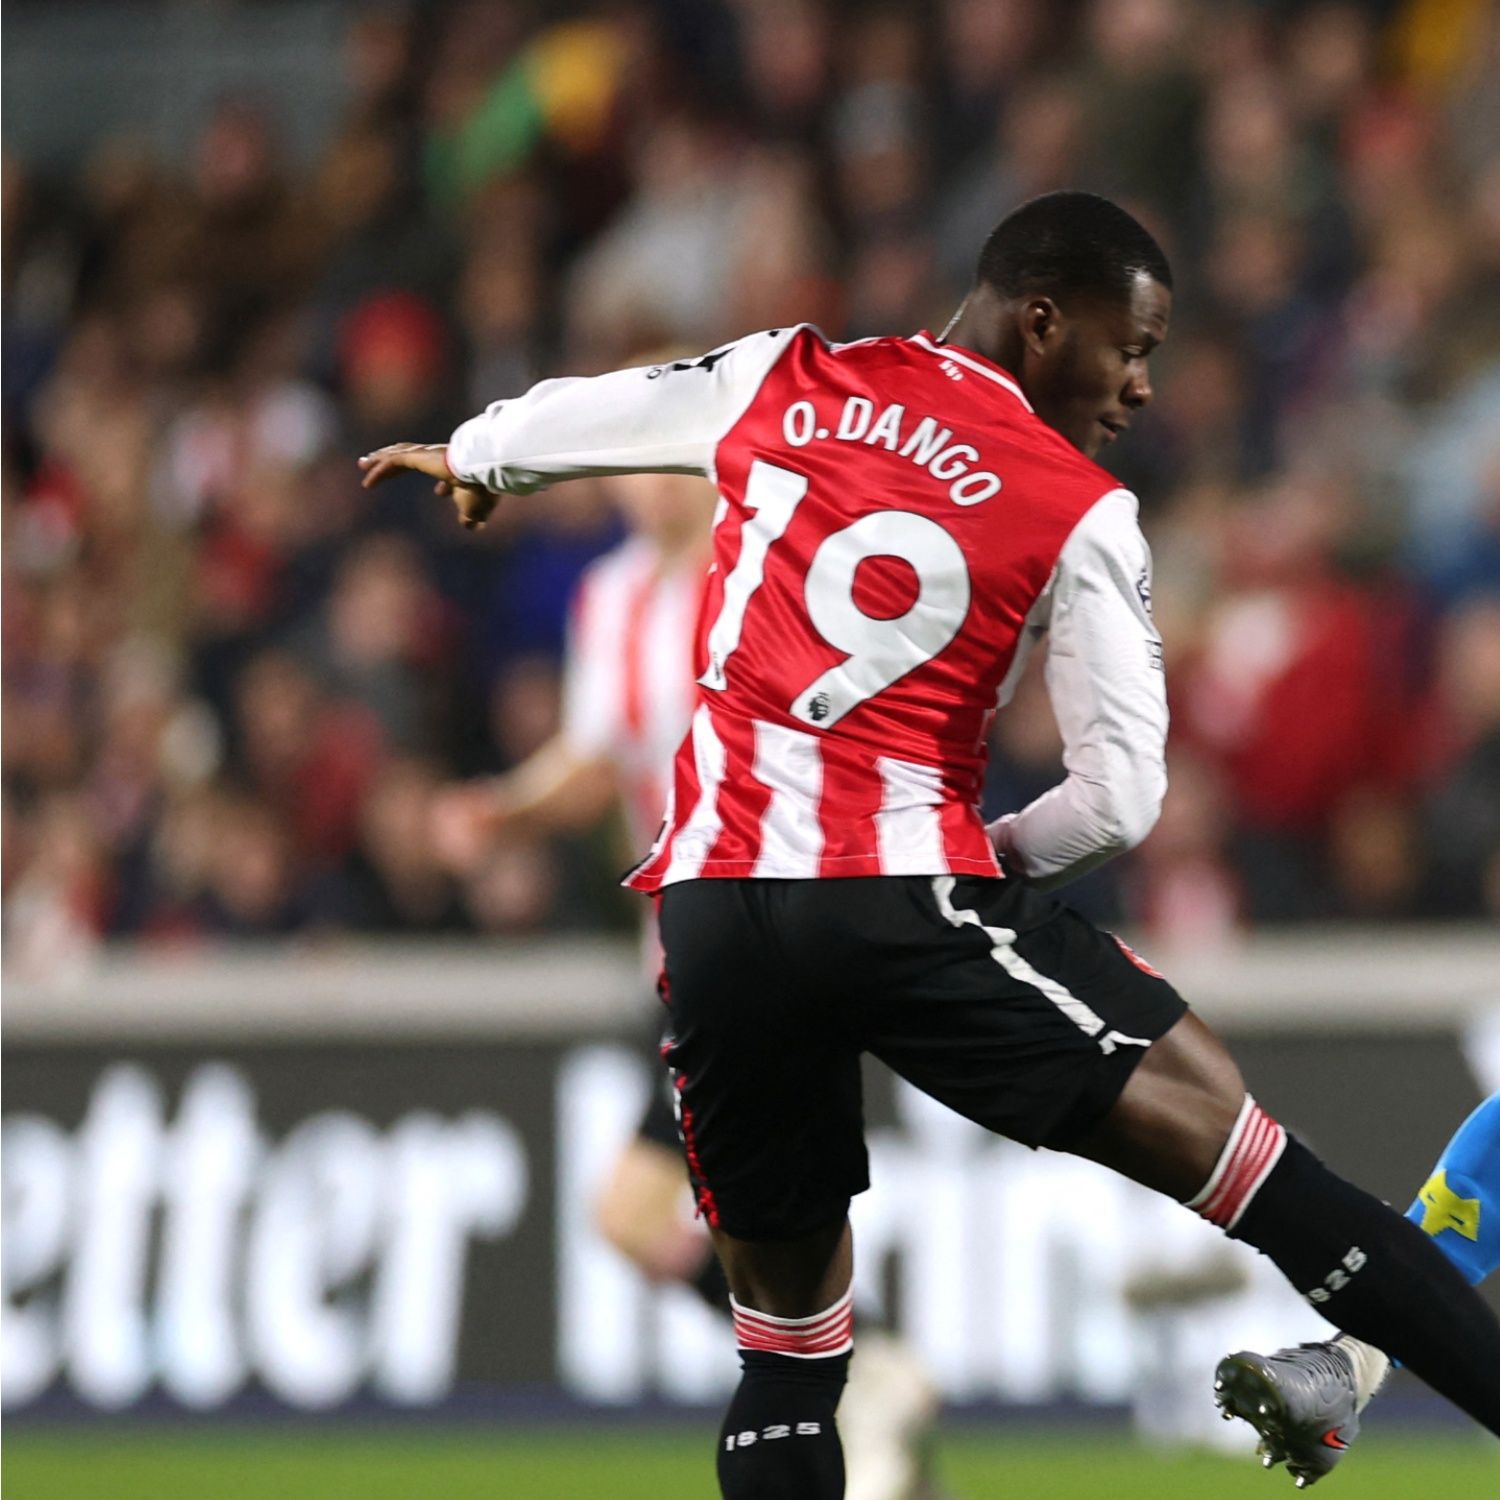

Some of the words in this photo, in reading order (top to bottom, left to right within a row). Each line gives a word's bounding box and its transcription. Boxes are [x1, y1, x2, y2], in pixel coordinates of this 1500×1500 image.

[696, 460, 970, 729] 19
[1304, 1246, 1367, 1304] 825
[725, 1422, 821, 1451] 1825
